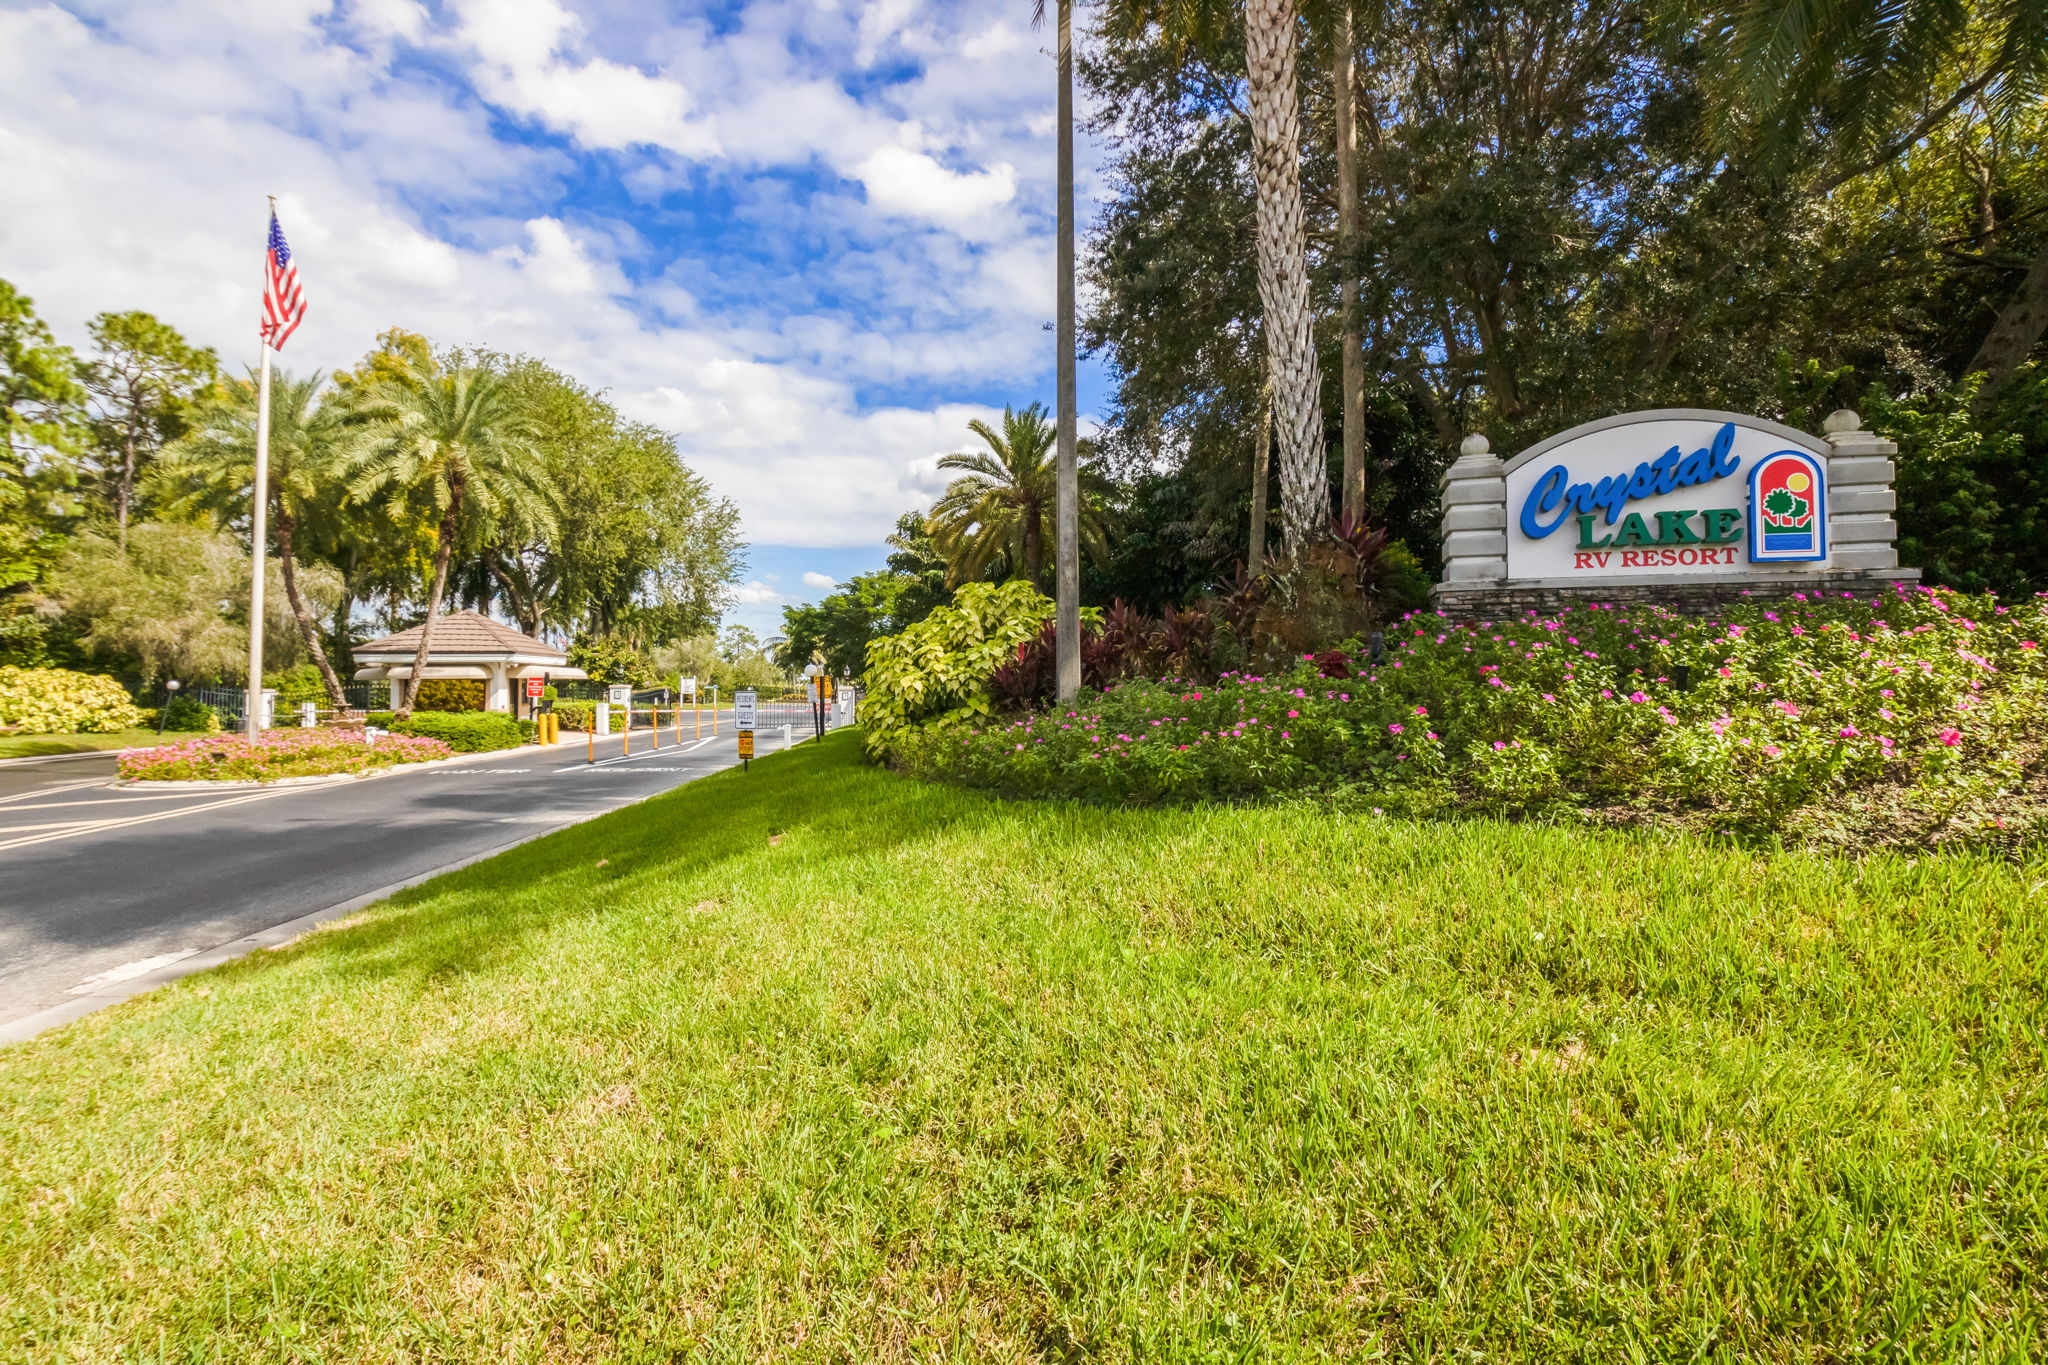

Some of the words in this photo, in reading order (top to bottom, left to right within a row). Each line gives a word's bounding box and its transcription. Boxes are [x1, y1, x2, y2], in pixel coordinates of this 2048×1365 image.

[1520, 422, 1741, 540] Crystal
[1576, 508, 1745, 550] LAKE
[1574, 551, 1612, 569] RV
[1621, 547, 1739, 568] RESORT
[737, 711, 754, 720] GUESTS
